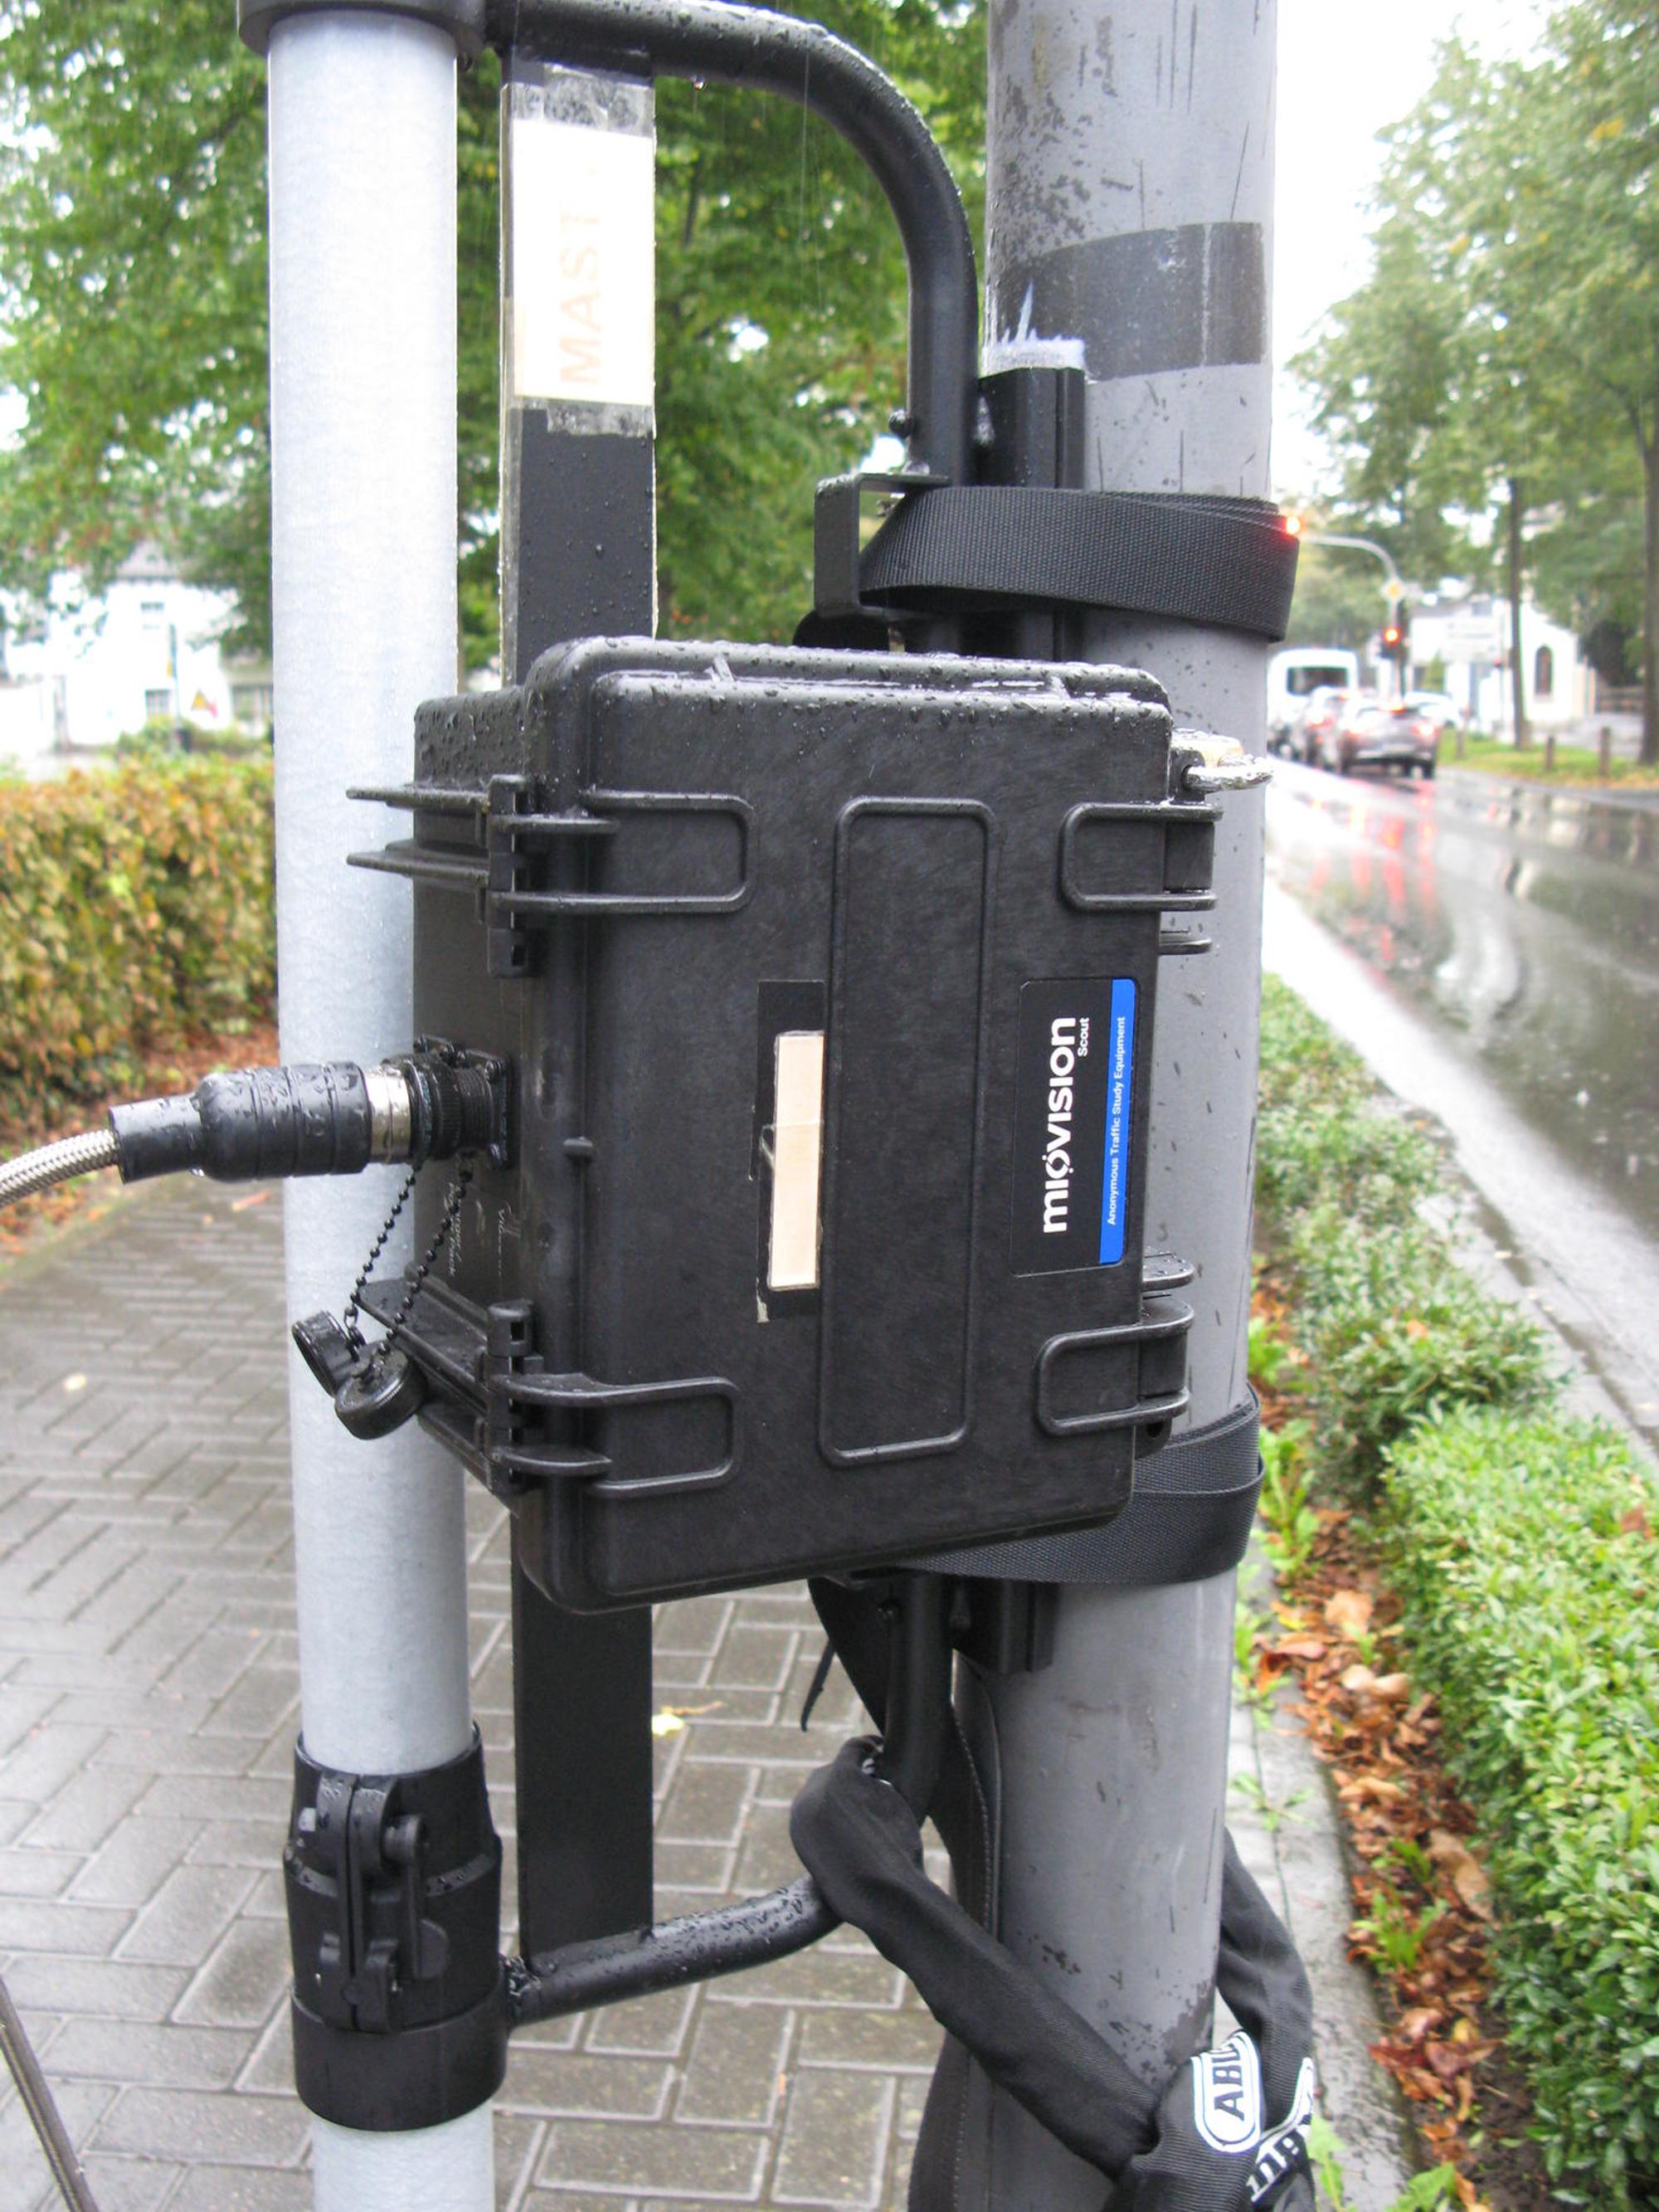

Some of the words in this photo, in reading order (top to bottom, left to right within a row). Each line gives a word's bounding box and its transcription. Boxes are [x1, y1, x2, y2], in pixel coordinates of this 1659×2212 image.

[1077, 1016, 1090, 1058] Scout
[1114, 1016, 1126, 1079] Equipment
[1112, 1081, 1124, 1115] Study
[1110, 1117, 1121, 1156] Traffic
[1107, 1157, 1119, 1226] Anonymous
